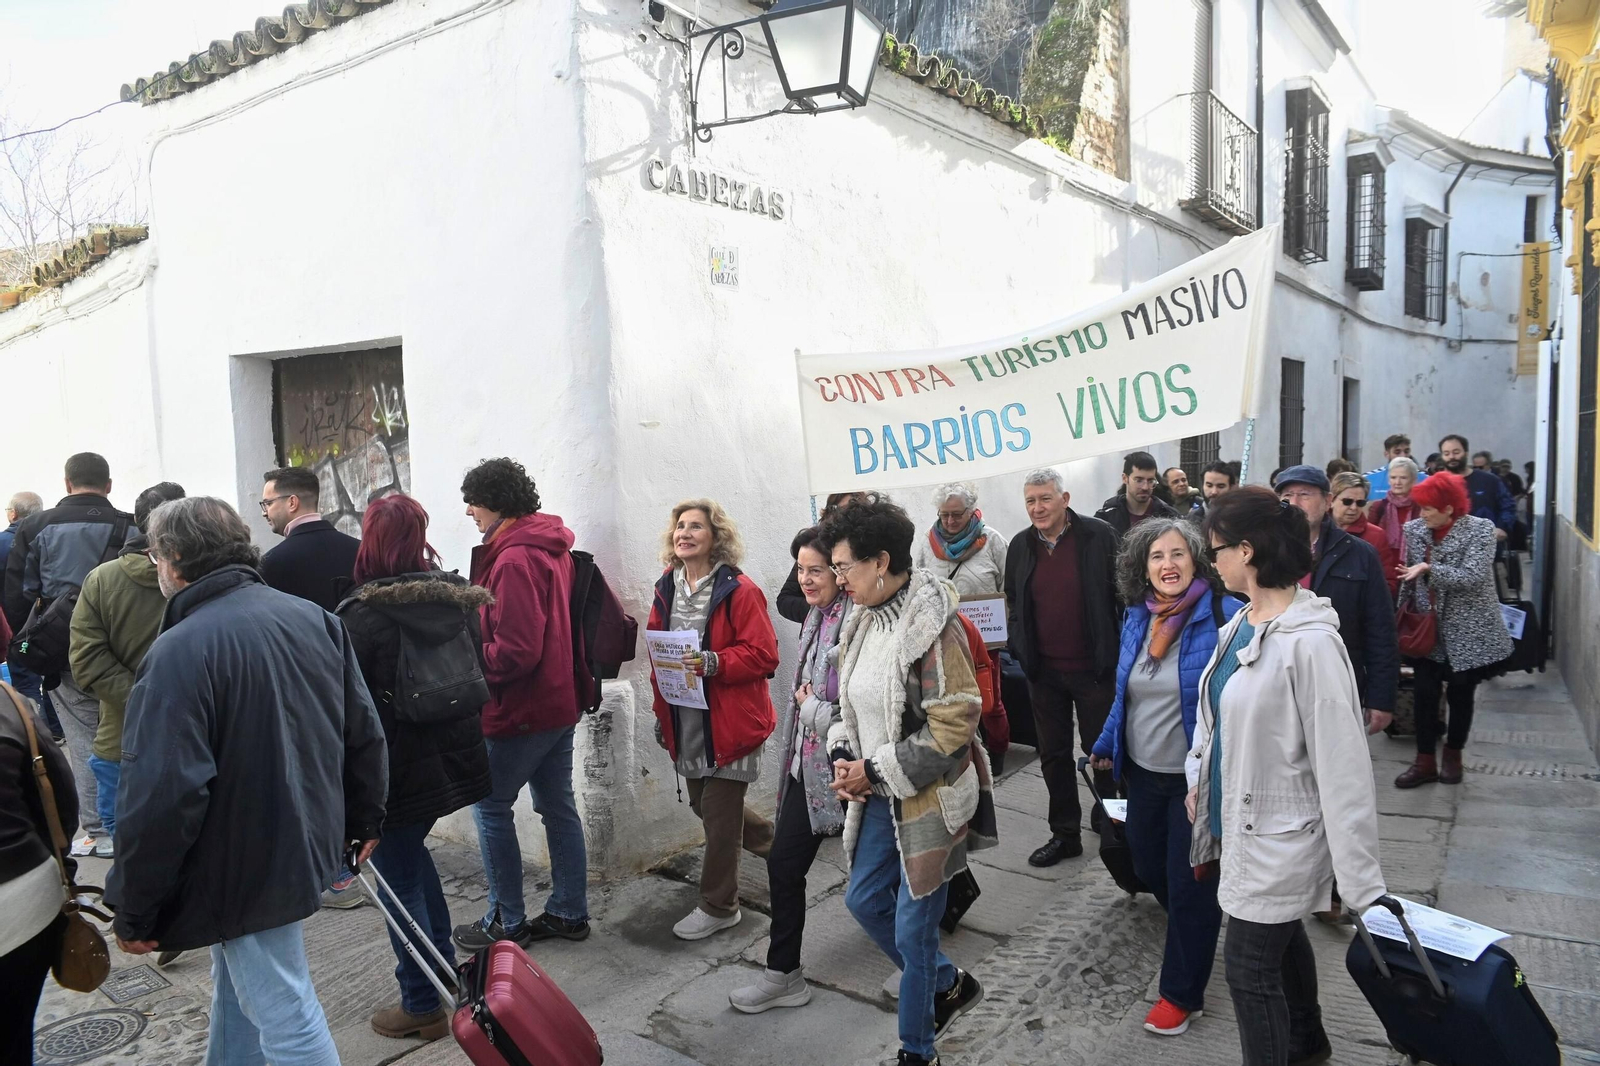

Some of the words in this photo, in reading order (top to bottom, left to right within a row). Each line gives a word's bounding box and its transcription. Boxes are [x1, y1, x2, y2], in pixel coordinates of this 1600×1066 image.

[644, 158, 785, 221] CABEZAS
[710, 267, 739, 286] CABEZAS
[1529, 247, 1543, 287] Reunidos
[1526, 287, 1543, 319] Juegos
[814, 364, 956, 403] CONTRA
